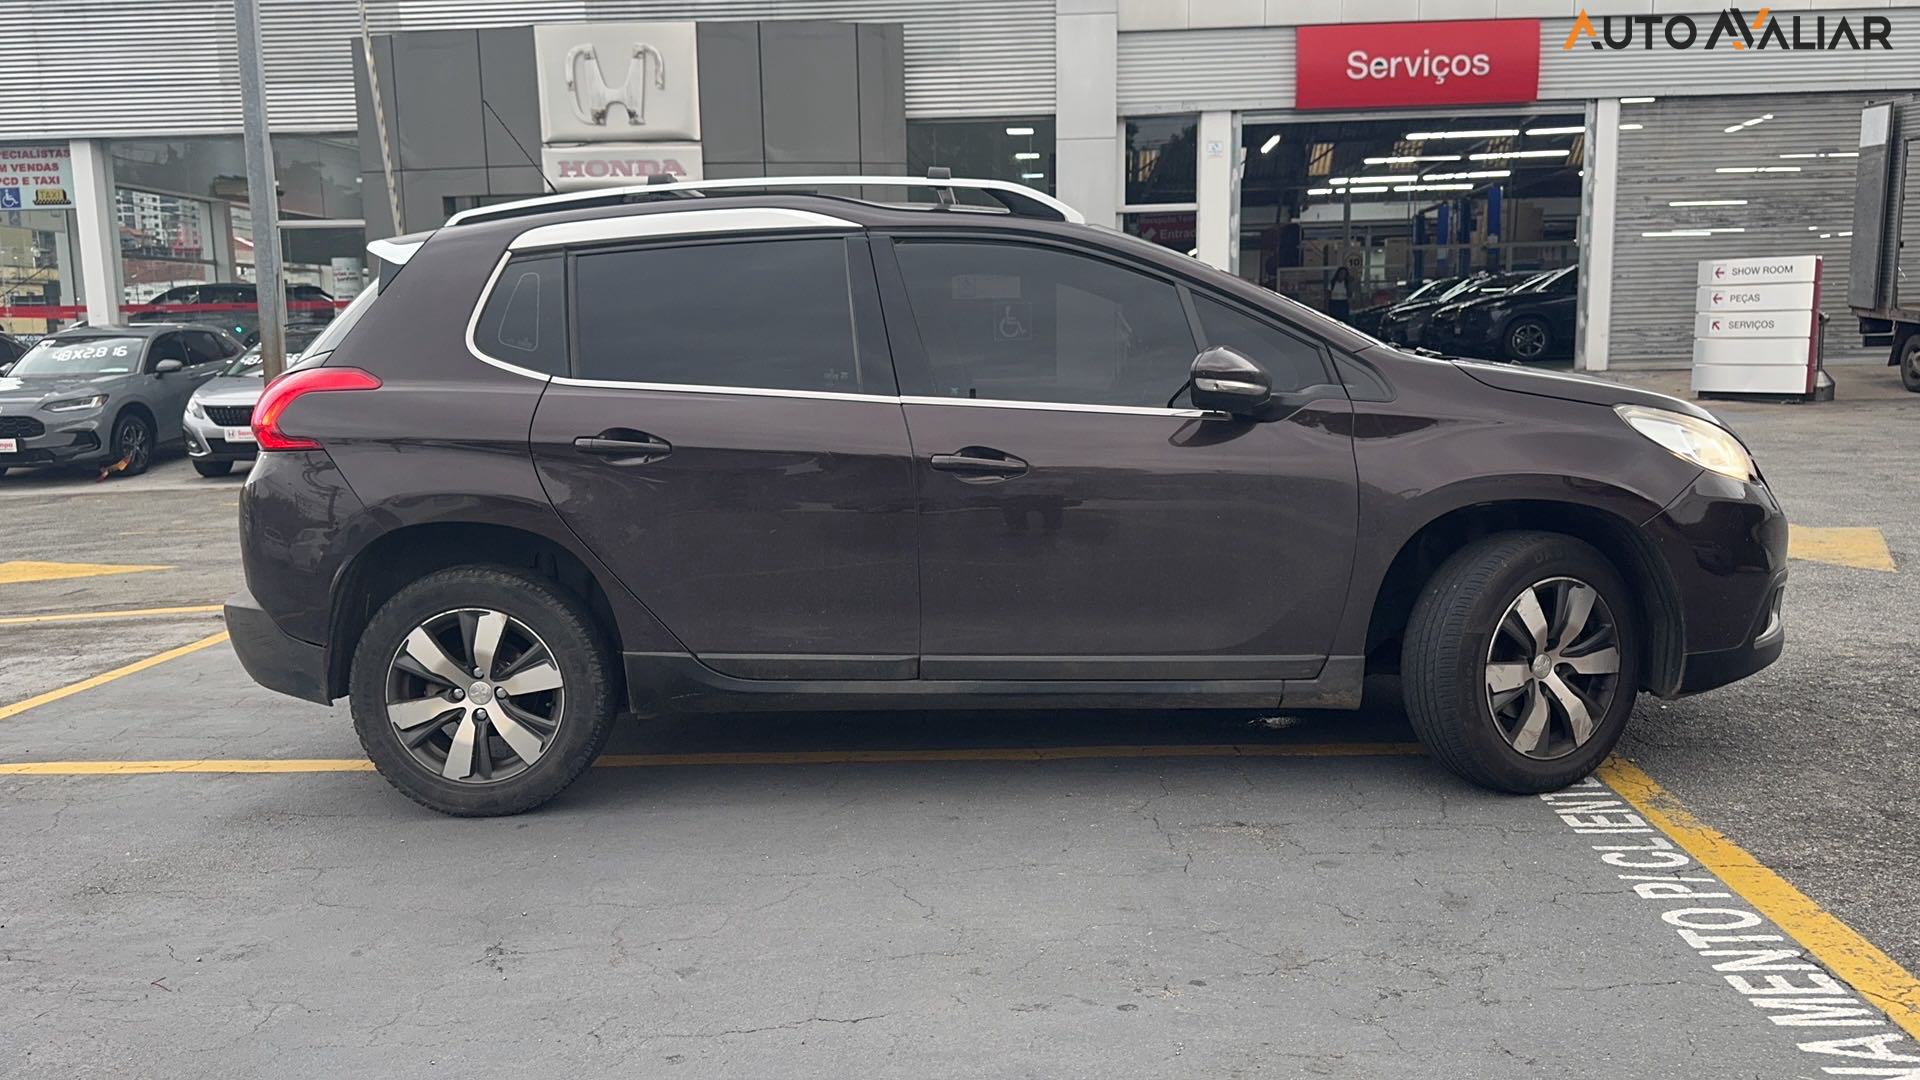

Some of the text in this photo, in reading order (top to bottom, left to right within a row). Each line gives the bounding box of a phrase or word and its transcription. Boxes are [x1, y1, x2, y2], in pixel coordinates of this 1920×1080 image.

[1346, 48, 1490, 84] Serviços
[0, 149, 70, 160] ECIALISTAS
[10, 163, 59, 172] VENDAS
[558, 159, 687, 178] HONDA
[0, 176, 61, 186] CD E TAXI
[40, 191, 61, 199] TAXI
[1348, 258, 1360, 267] 10
[1731, 265, 1794, 276] SHOW ROOM
[1729, 294, 1760, 303] PEÇAS
[1728, 320, 1775, 330] SERVIÇOS
